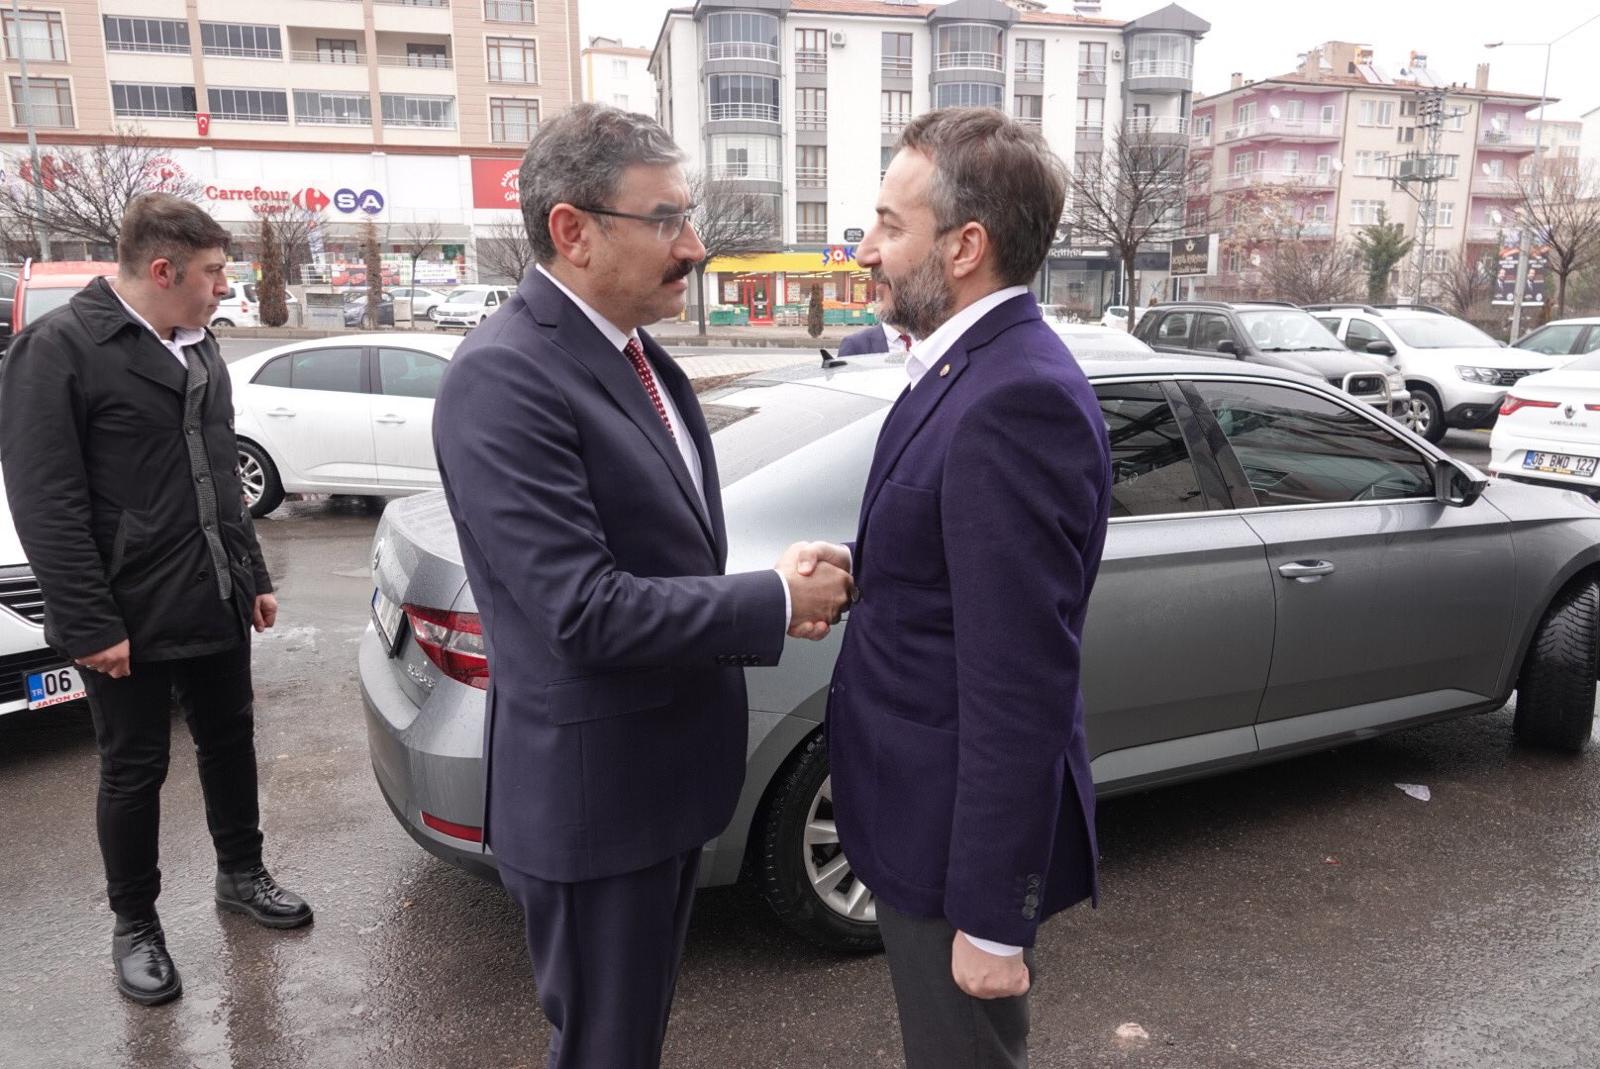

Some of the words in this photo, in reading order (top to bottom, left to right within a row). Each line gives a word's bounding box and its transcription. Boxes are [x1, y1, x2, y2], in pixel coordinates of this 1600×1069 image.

[205, 185, 290, 201] Carrefour
[336, 190, 383, 212] SA
[822, 246, 856, 266] ŞOK
[1576, 458, 1594, 472] 122
[45, 670, 72, 696] 06
[35, 695, 70, 708] JAPON
[73, 690, 86, 699] OT
